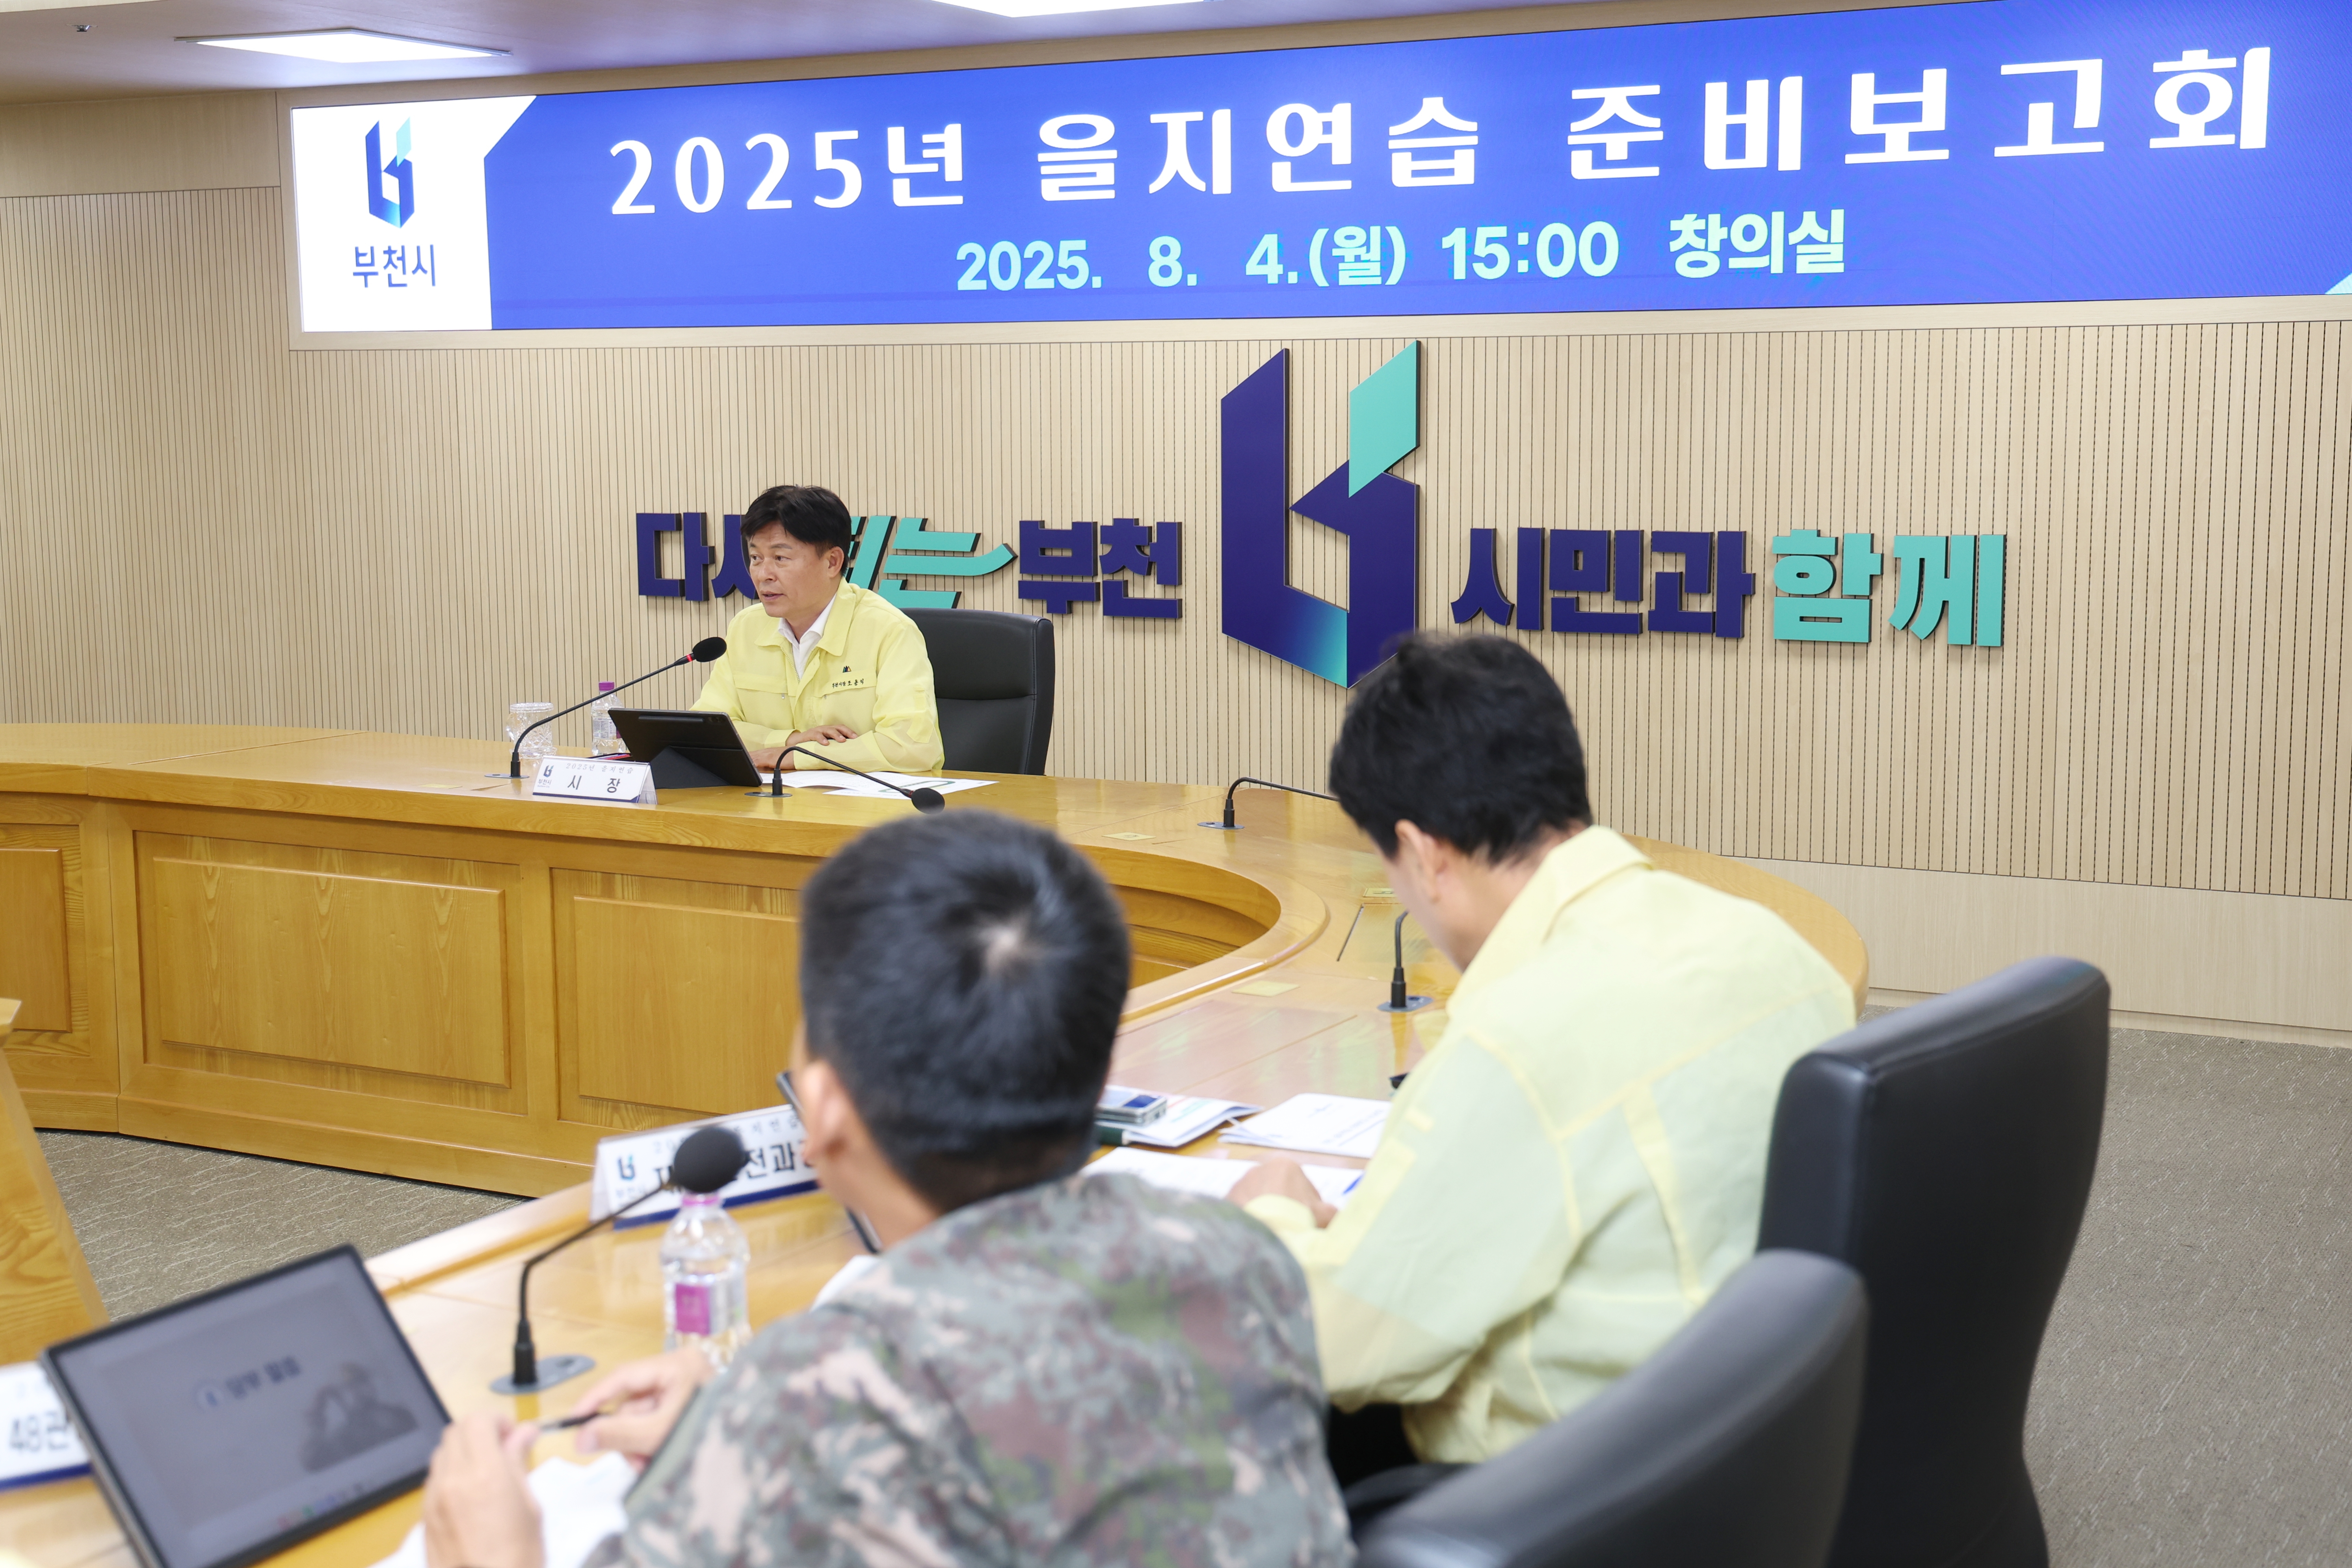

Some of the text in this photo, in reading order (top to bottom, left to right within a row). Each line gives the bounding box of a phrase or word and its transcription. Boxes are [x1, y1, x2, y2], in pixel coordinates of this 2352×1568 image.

[610, 47, 2271, 215] 2025년 을지연습 준비보고회
[353, 244, 436, 288] 부천시
[956, 239, 1102, 291] 2025.
[1148, 235, 1197, 287] 8.
[1441, 220, 1619, 280] 15:00
[1669, 208, 1846, 279] 창의실
[843, 515, 1018, 609] 는
[1018, 518, 1183, 619] 부천
[1451, 527, 1755, 639] 시민과
[1772, 529, 2007, 647] 함께
[565, 763, 634, 774] 2025년 을지연습
